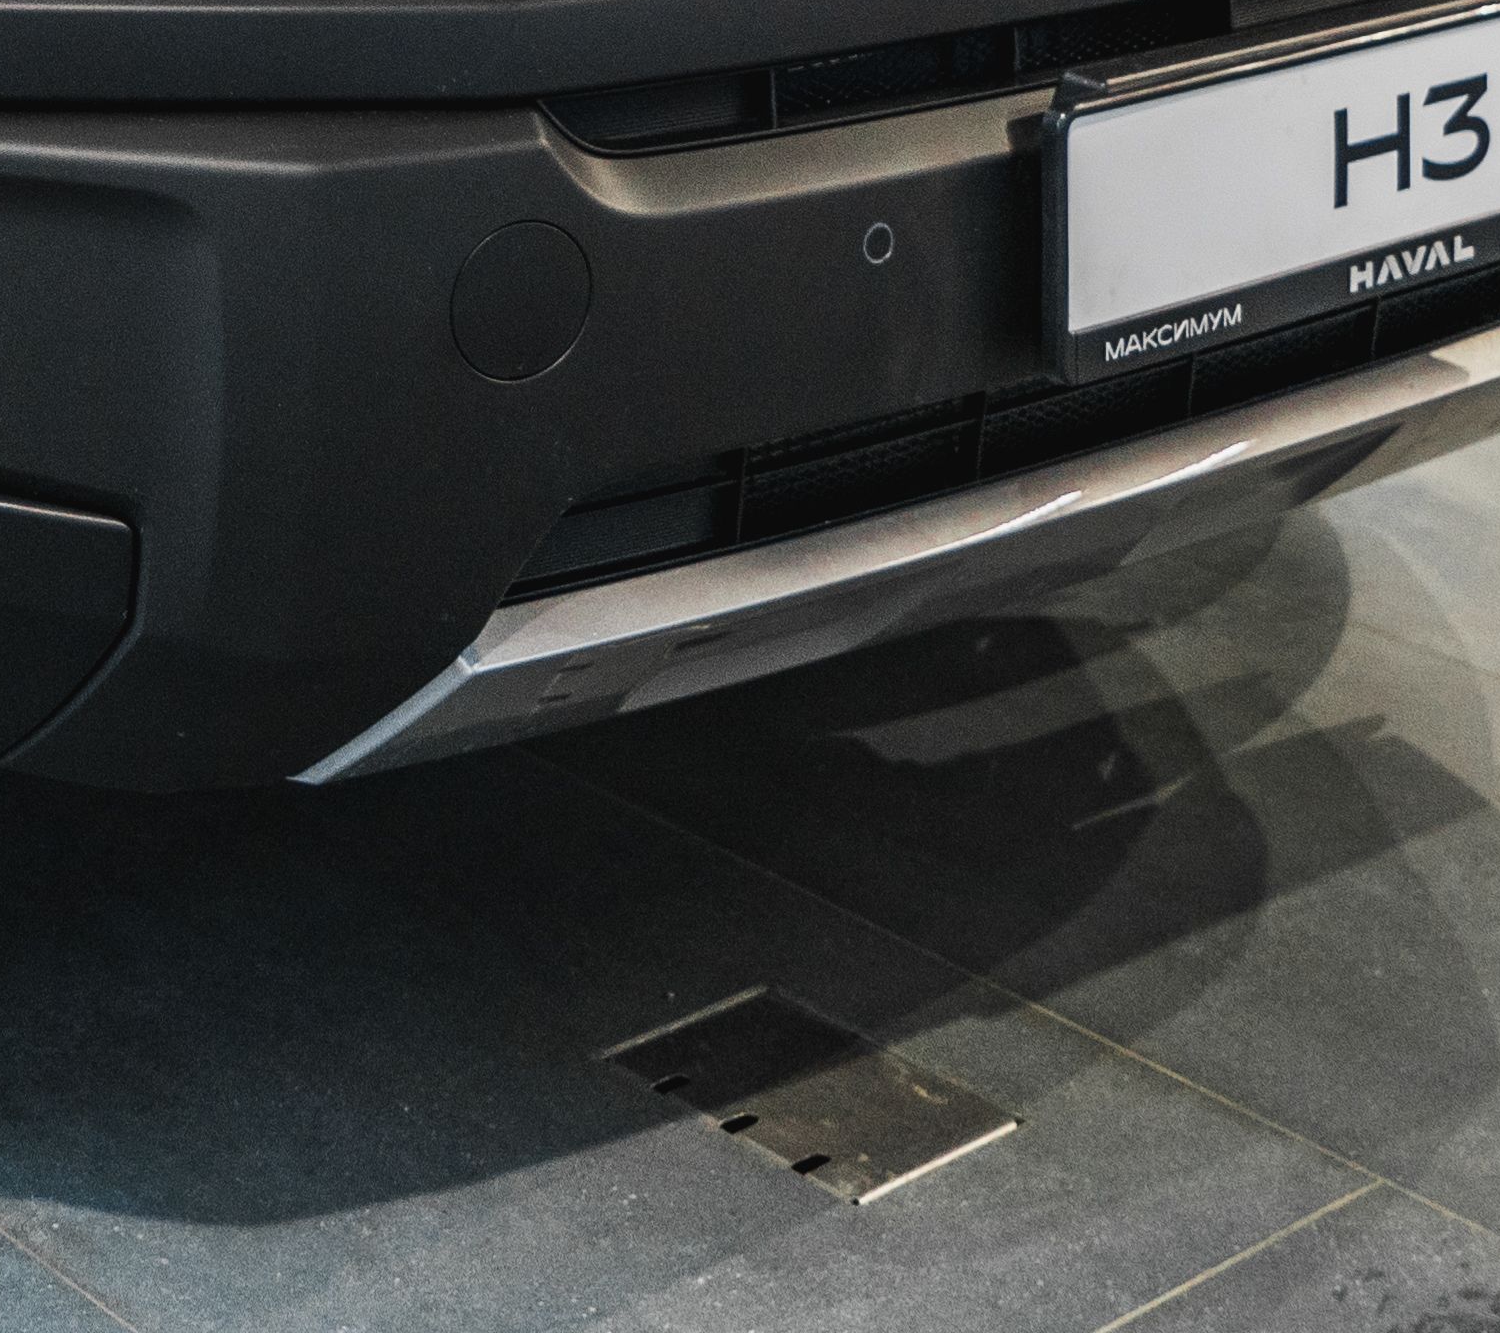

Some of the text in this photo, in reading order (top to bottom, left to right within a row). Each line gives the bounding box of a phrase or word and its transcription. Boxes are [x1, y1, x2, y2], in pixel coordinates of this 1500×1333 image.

[1332, 71, 1492, 210] H3
[1347, 234, 1477, 295] HAVAL
[1104, 302, 1244, 363] МАКСИМУМ
